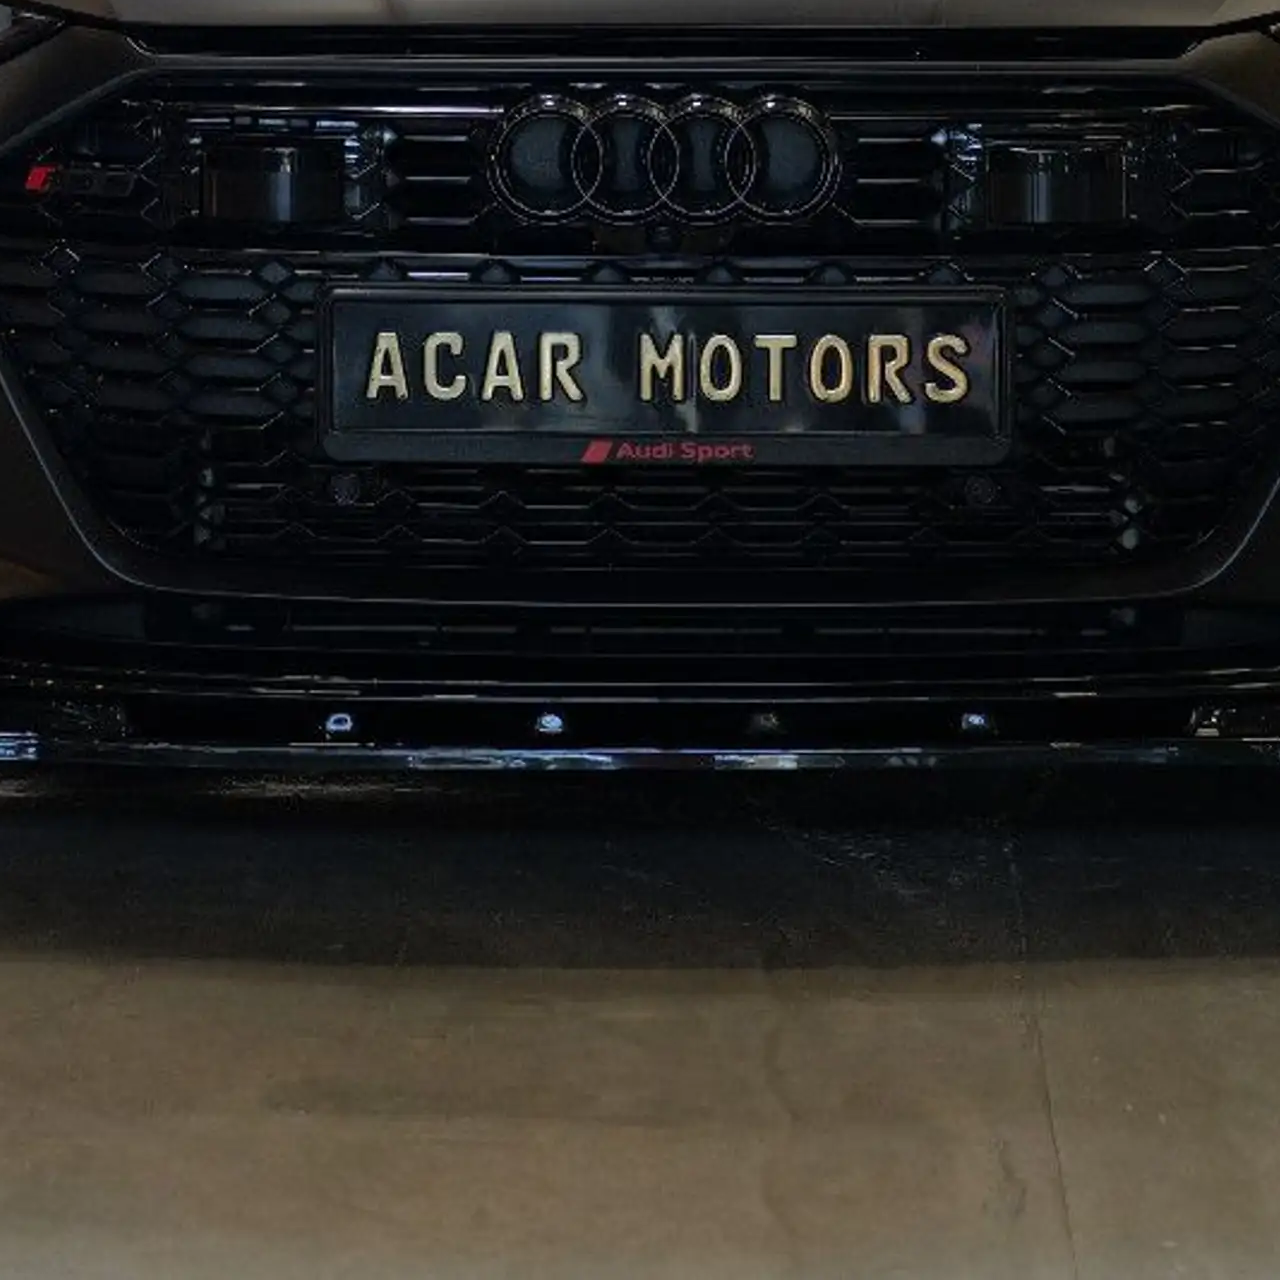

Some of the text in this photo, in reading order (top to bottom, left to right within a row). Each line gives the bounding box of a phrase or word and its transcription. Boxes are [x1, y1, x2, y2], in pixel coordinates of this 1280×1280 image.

[366, 330, 969, 404] ACAR MOTORS
[616, 442, 755, 462] Audi Sport
